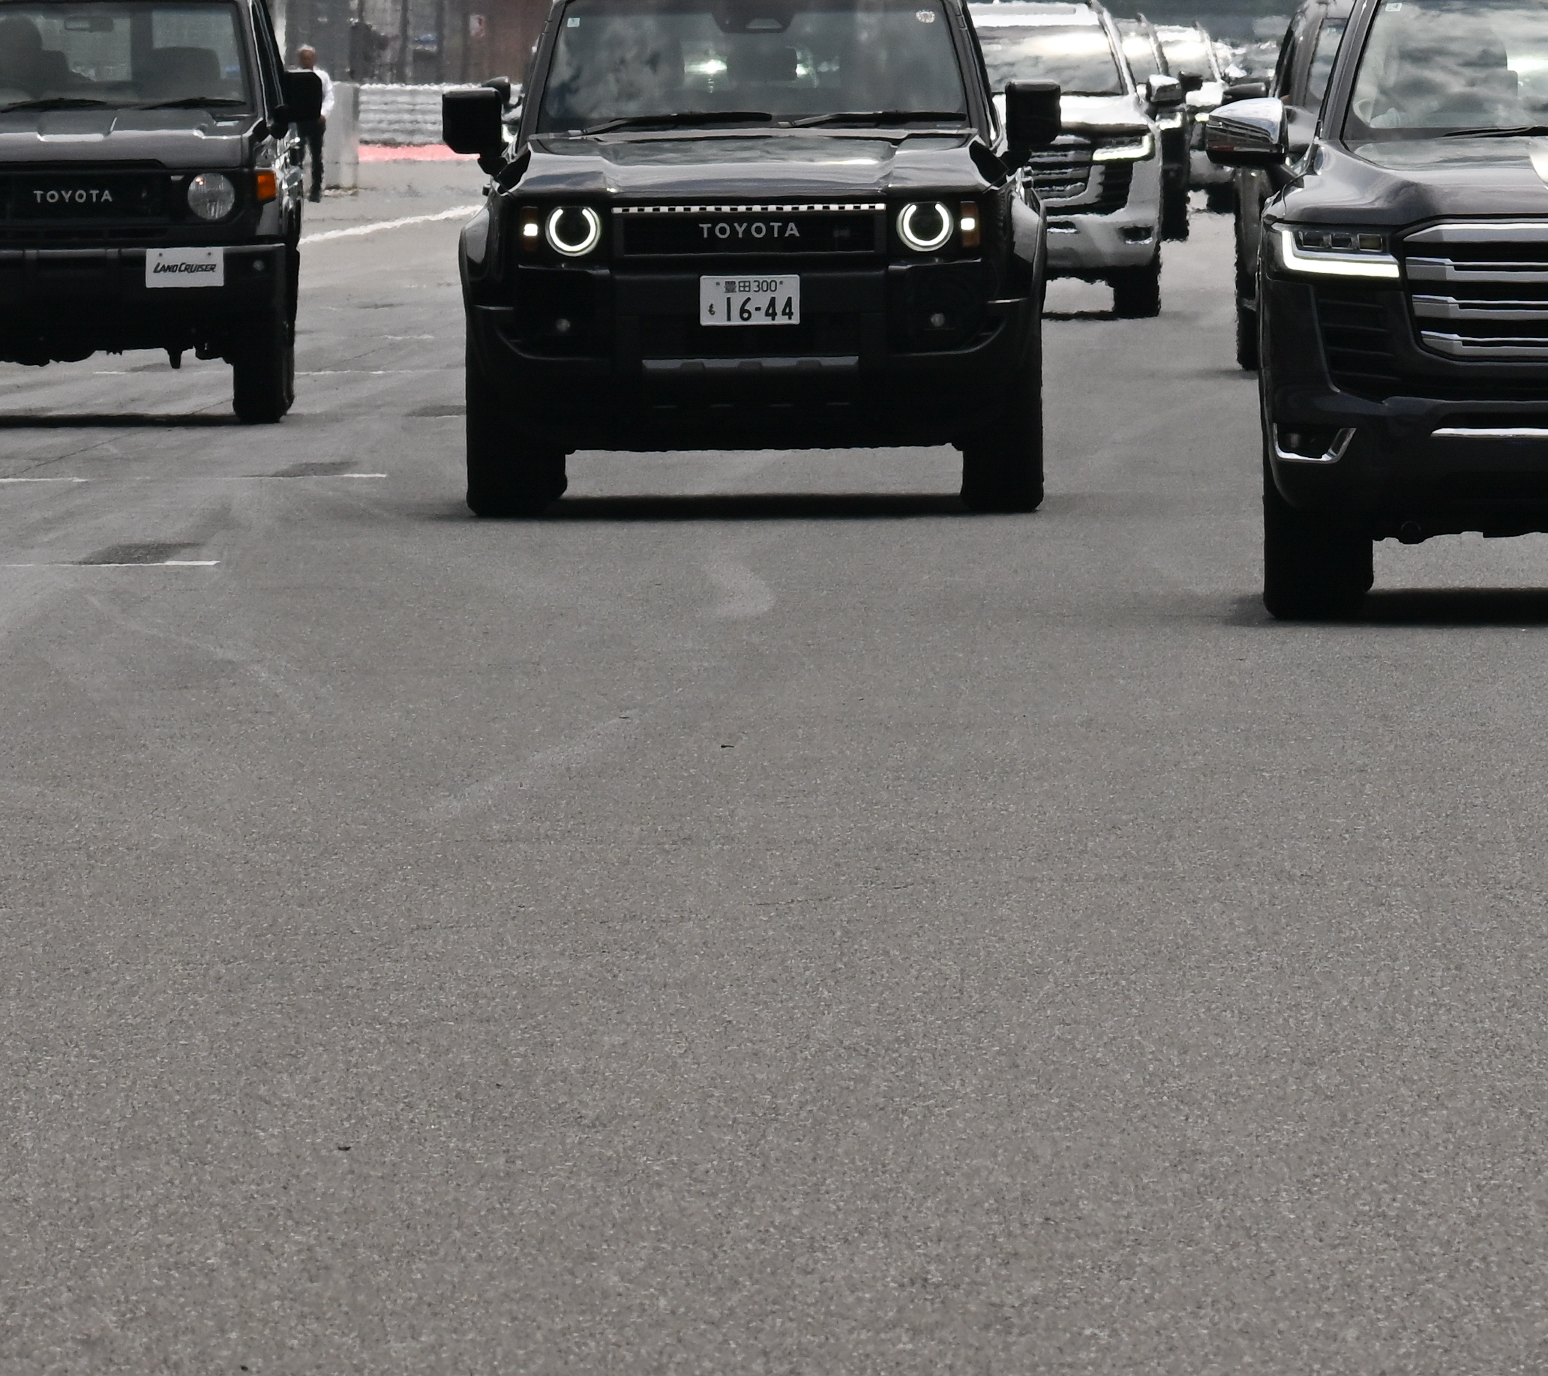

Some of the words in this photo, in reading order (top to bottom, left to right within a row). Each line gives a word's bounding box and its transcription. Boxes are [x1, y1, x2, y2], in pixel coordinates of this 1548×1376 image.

[33, 190, 113, 203] TOYOTA
[699, 222, 800, 239] TOYOTA
[726, 296, 794, 322] 16-44
